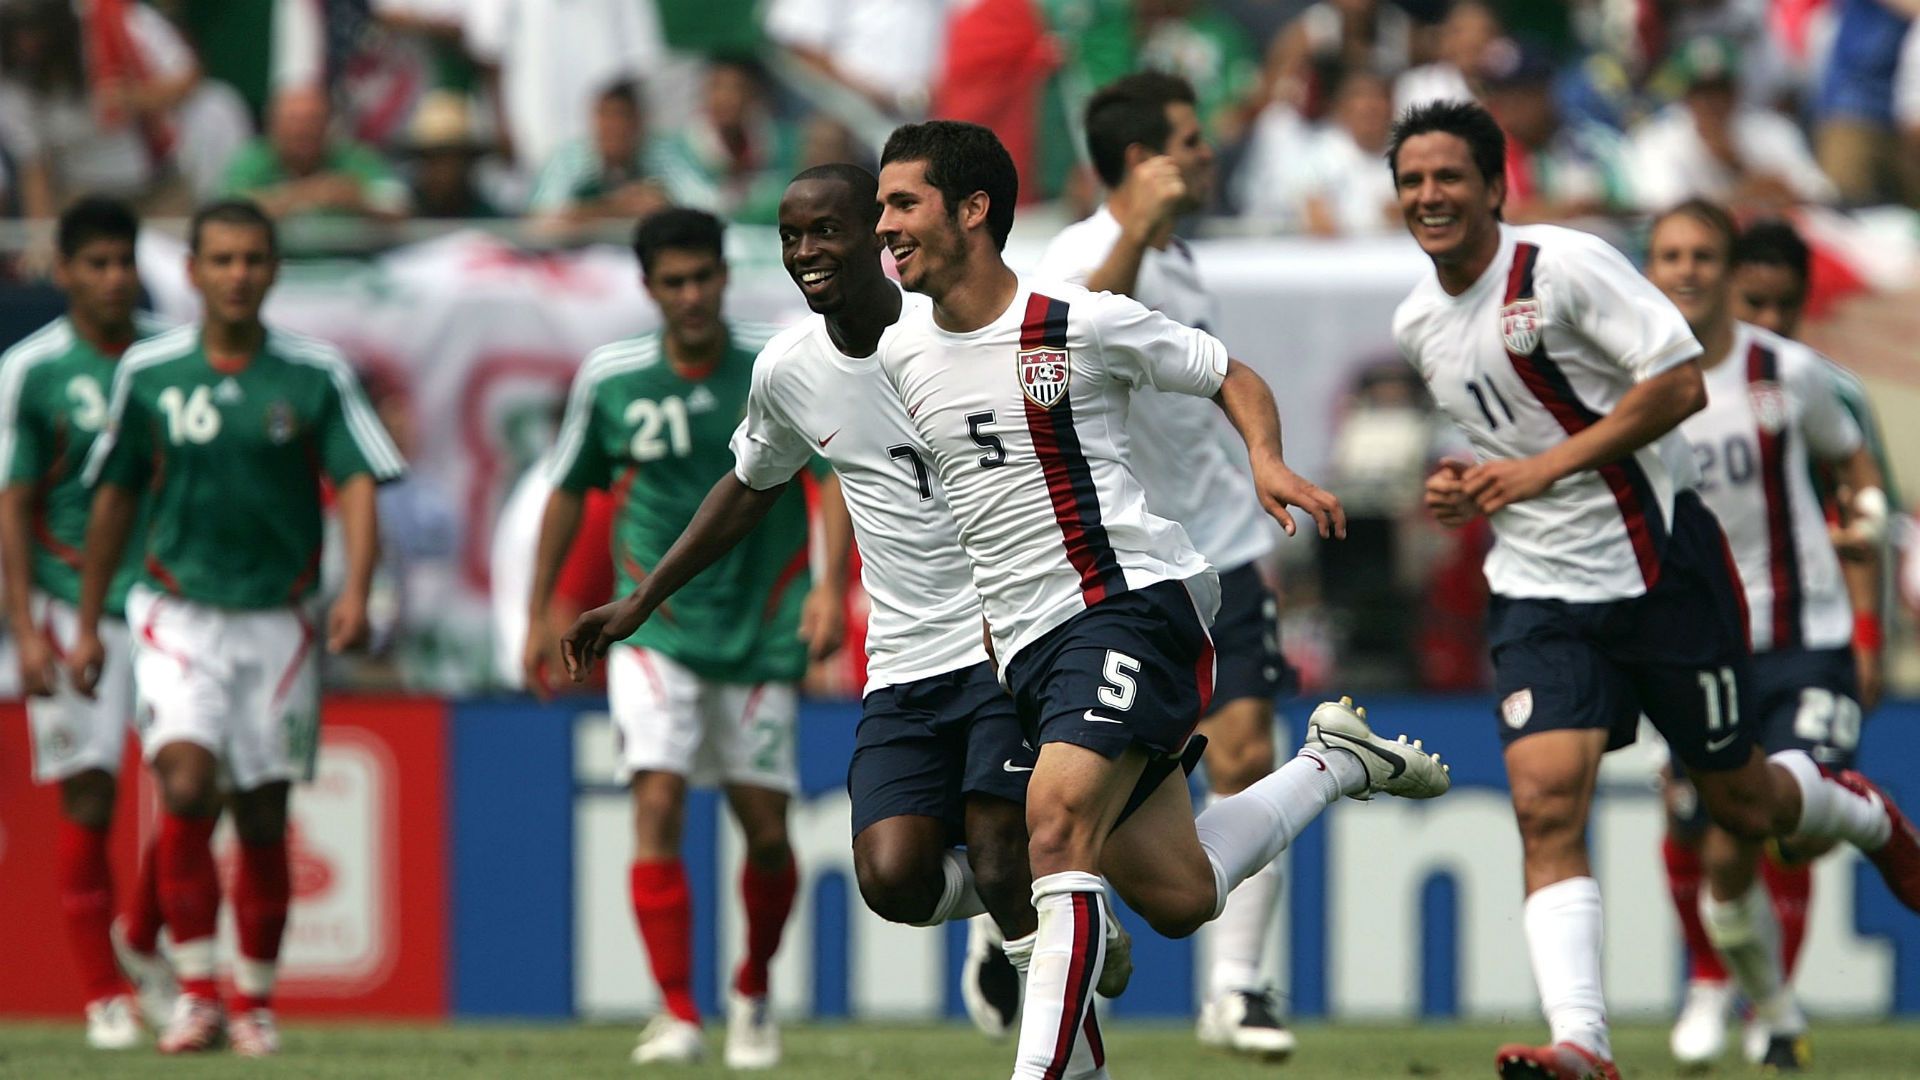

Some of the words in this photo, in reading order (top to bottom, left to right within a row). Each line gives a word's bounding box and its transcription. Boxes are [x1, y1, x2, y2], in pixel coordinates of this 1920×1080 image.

[66, 374, 108, 432] 3
[158, 384, 221, 445] 16
[624, 395, 691, 462] 21
[1465, 374, 1516, 431] 11
[964, 409, 1008, 469] 5
[1693, 434, 1754, 492] 20
[886, 443, 934, 502] 7
[1097, 648, 1141, 712] 5
[1698, 666, 1740, 730] 11
[1795, 686, 1862, 750] 20
